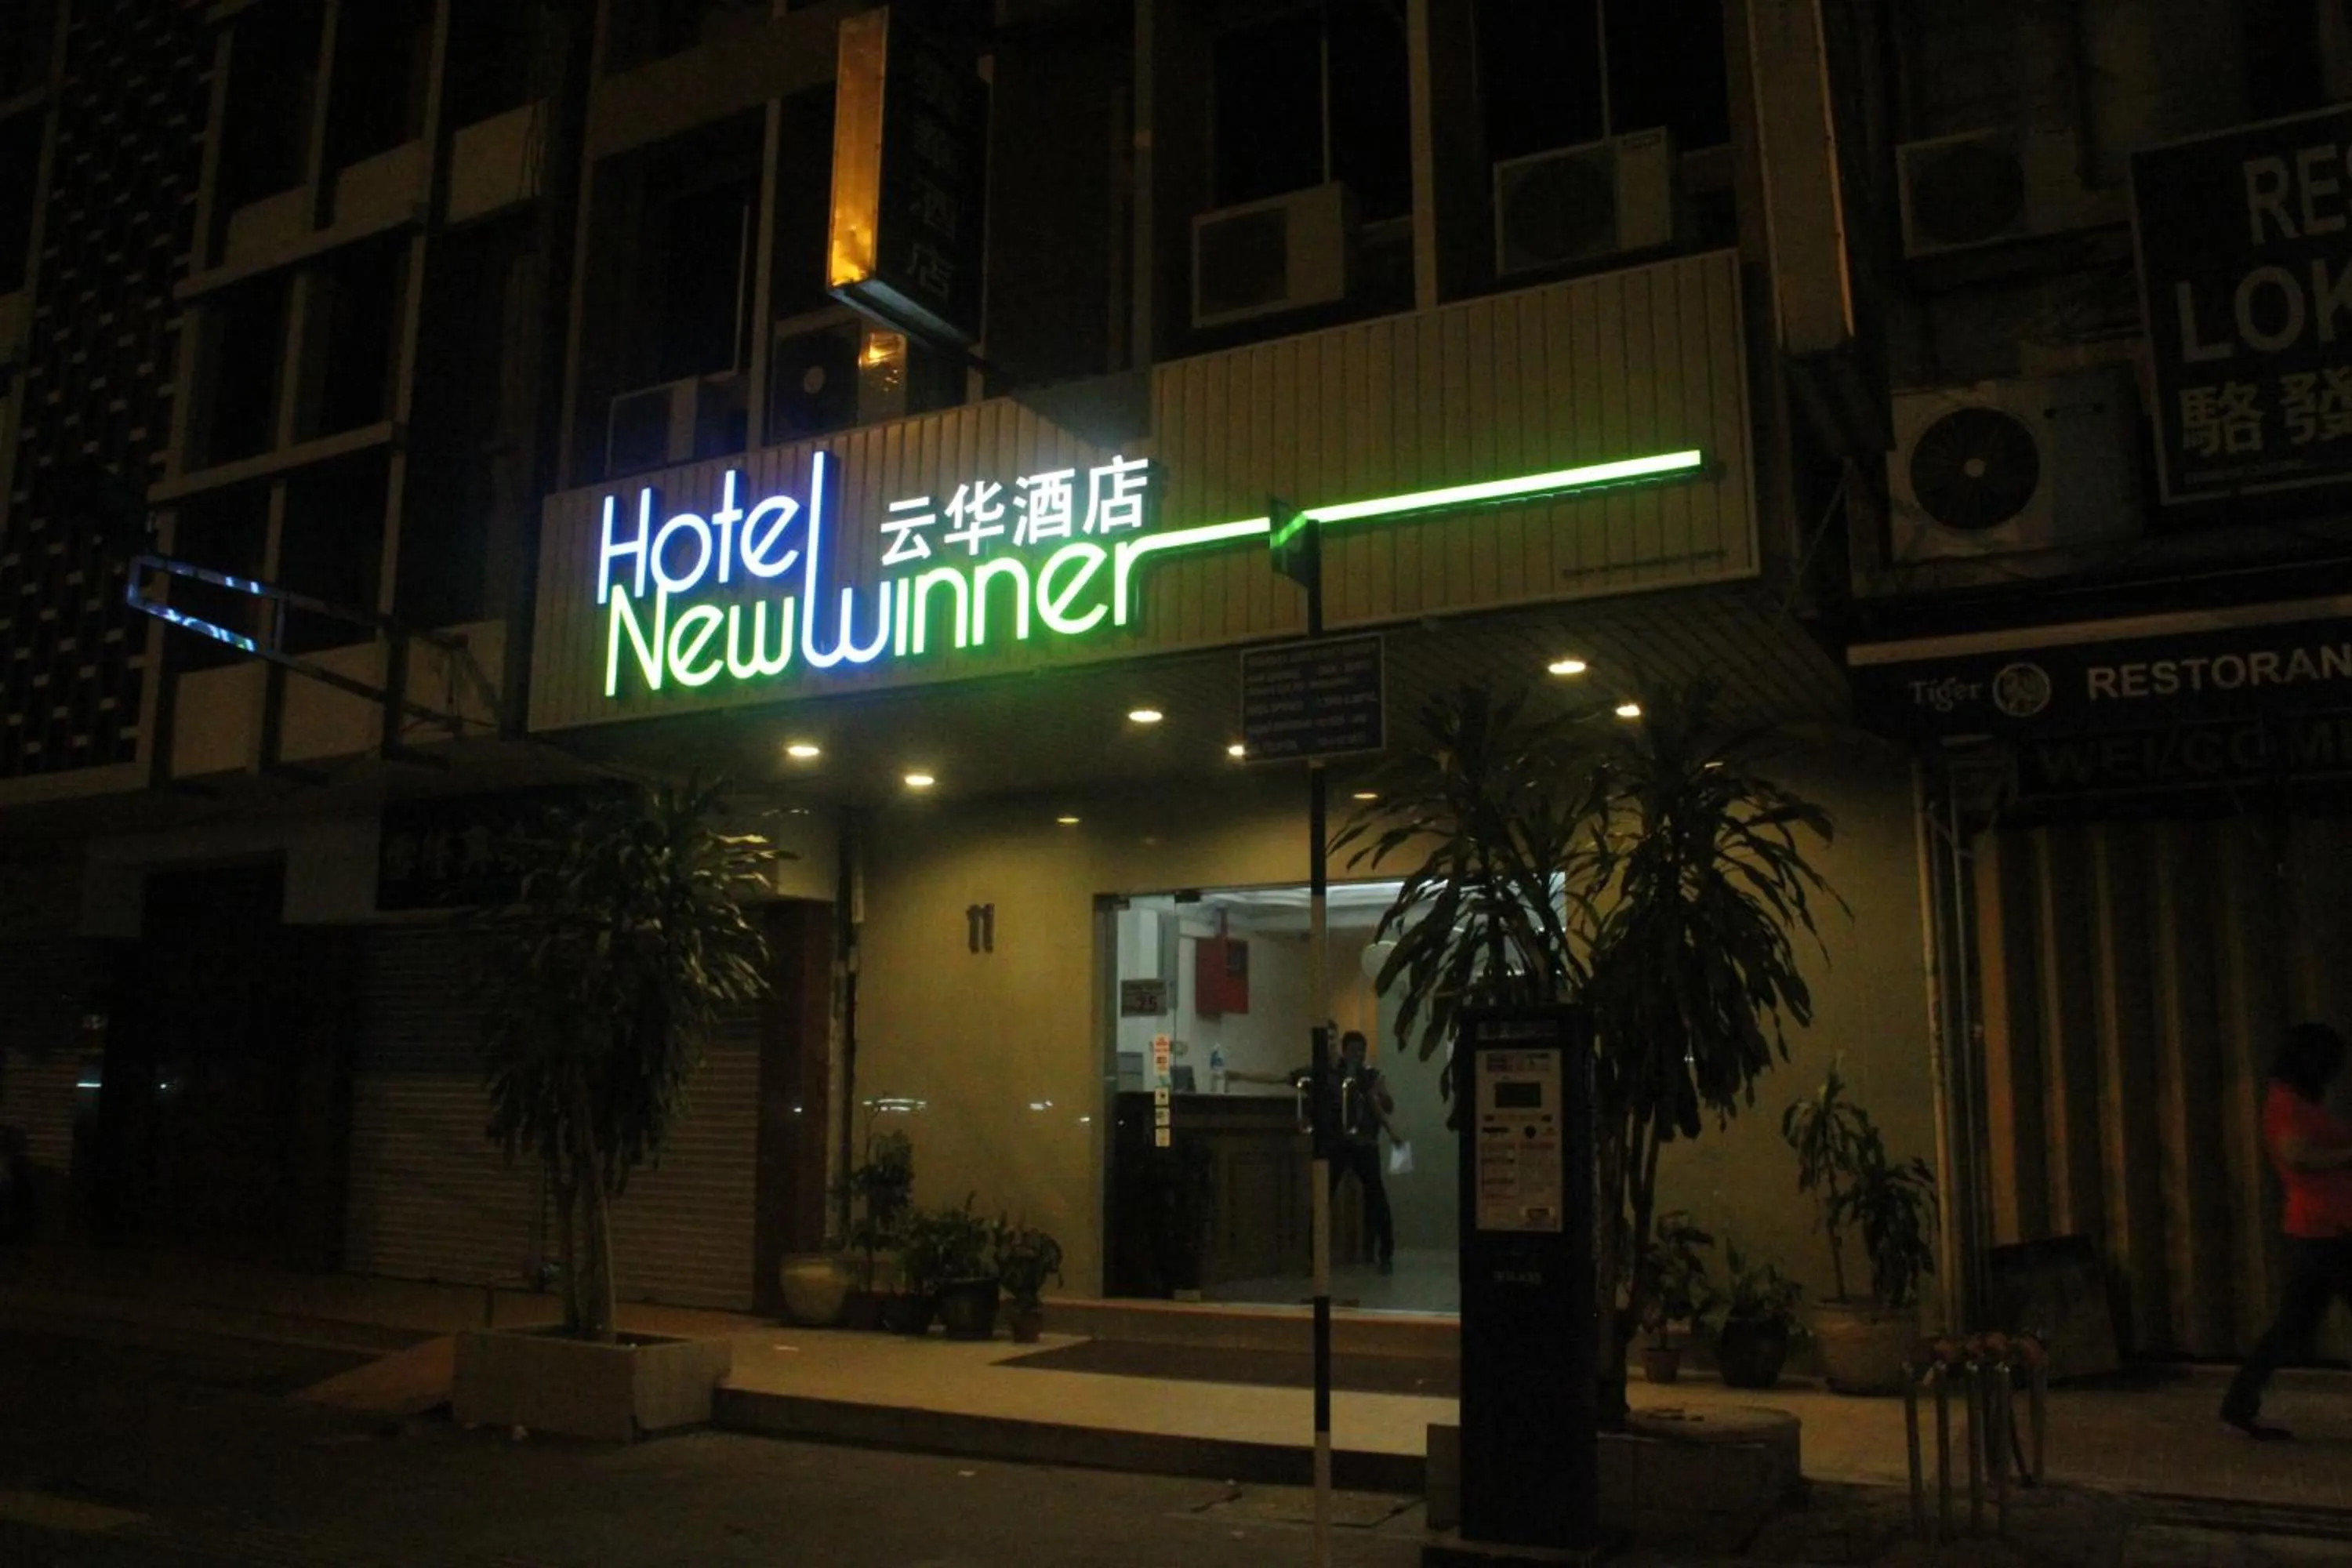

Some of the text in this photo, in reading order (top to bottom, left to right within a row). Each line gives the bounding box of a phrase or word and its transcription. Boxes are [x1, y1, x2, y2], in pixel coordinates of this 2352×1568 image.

[2243, 143, 2352, 246] RE
[597, 451, 826, 605] Hotel
[880, 454, 1149, 566] 云华酒店
[1909, 675, 1985, 711] Tiger
[2086, 641, 2352, 702] RESTORAN
[2035, 718, 2352, 785] WELCOM
[966, 902, 994, 954] 11
